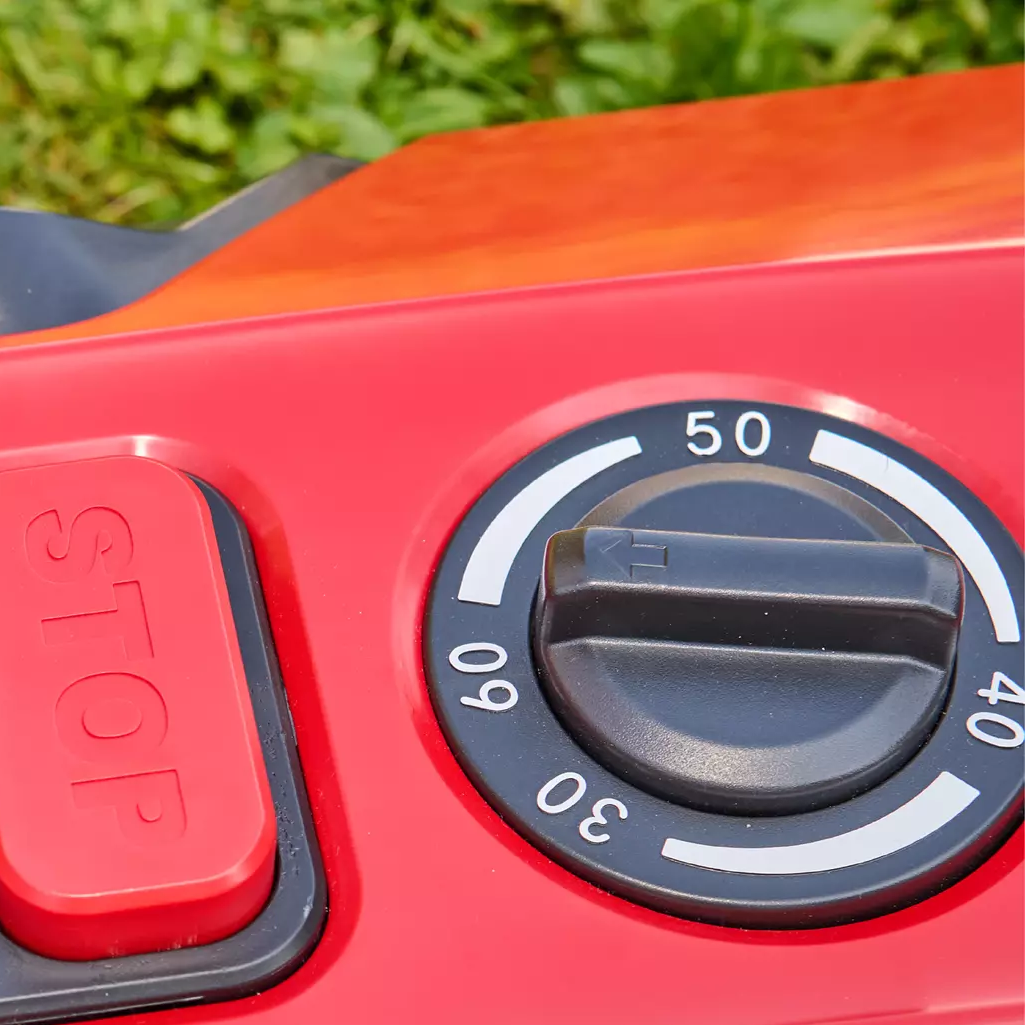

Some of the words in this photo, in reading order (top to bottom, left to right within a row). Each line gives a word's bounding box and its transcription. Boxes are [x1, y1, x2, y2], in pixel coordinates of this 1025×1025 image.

[685, 410, 772, 457] 50
[26, 506, 187, 850] STOP
[448, 642, 519, 712] 60
[965, 671, 1025, 749] 40
[536, 771, 628, 844] 30
